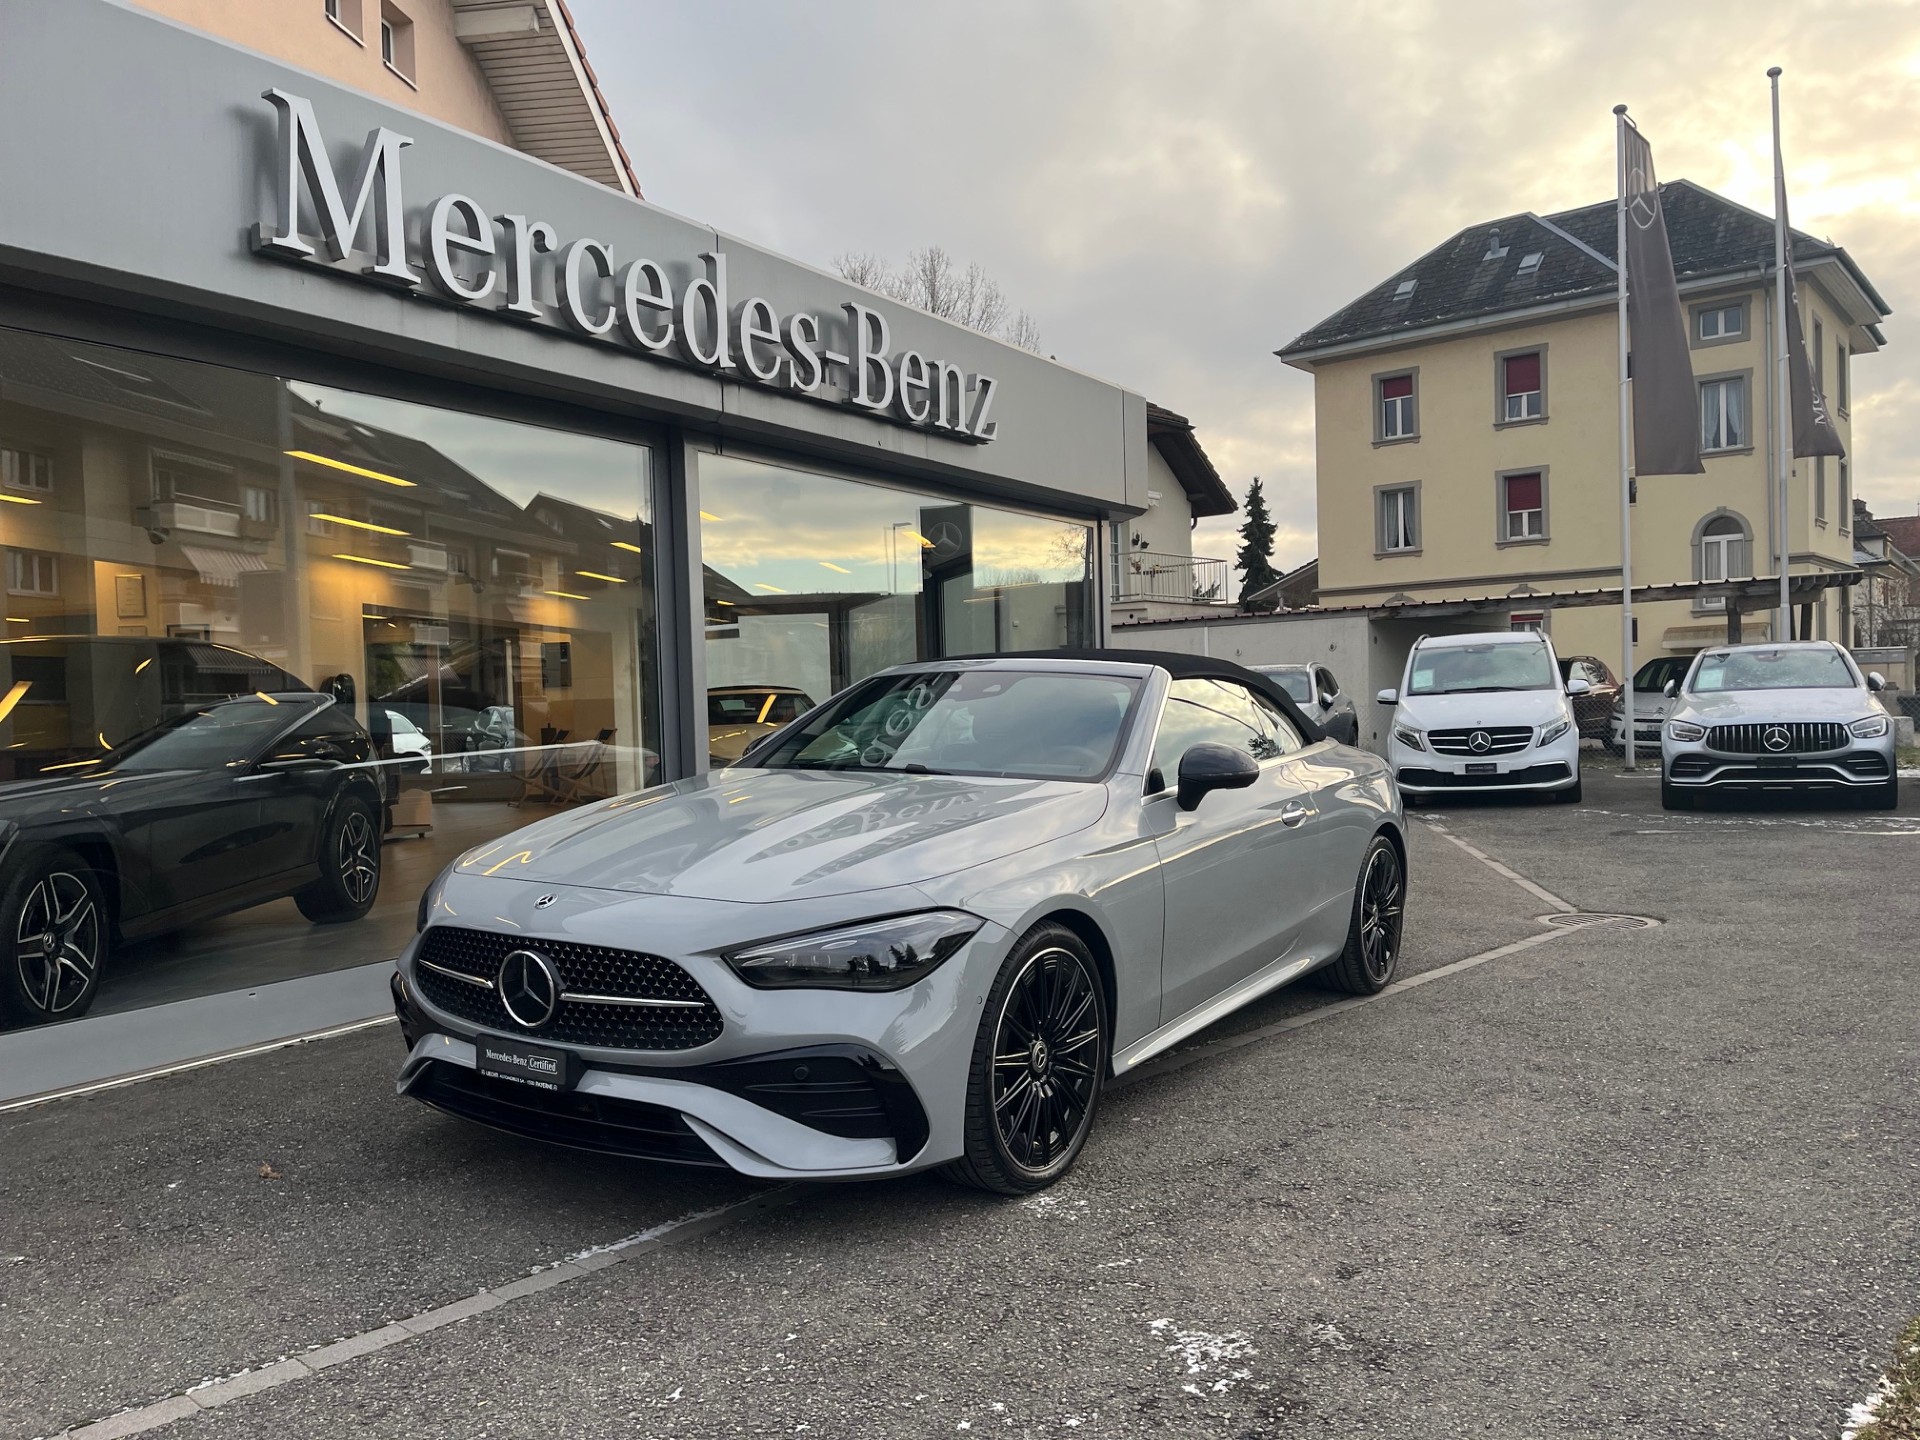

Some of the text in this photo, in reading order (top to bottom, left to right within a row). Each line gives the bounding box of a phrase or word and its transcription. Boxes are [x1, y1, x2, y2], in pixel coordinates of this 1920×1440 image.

[255, 88, 999, 443] Mercedes-Benz
[486, 1049, 556, 1071] Mercedes-Benz Certified
